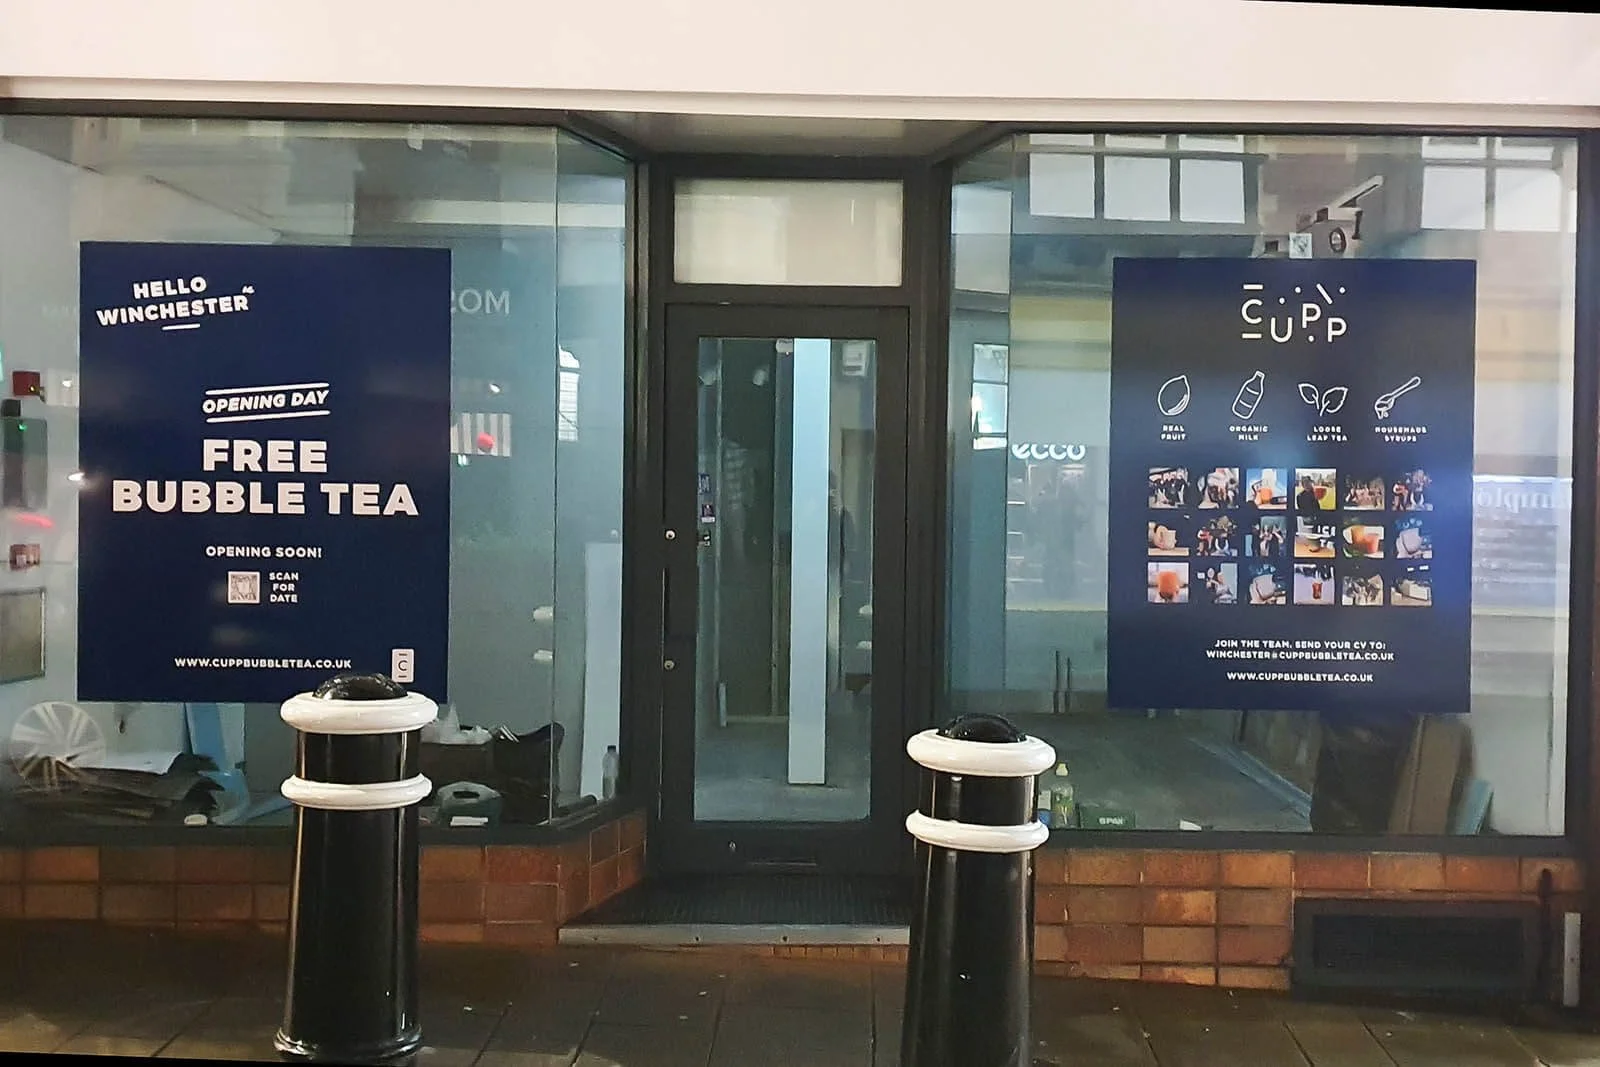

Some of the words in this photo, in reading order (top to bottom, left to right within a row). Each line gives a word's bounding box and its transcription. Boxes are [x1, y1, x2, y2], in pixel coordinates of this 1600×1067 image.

[132, 276, 207, 299] HELLO
[1241, 299, 1346, 342] CUPP
[203, 395, 286, 413] OPENING
[291, 389, 329, 406] DAY
[1229, 425, 1268, 433] ORGANIC
[204, 439, 327, 472] FREE
[113, 480, 305, 514] BUBBLE
[320, 483, 418, 515] TEA
[205, 545, 272, 558] OPENING
[275, 546, 322, 558] SOON!
[269, 572, 299, 581] SCAN
[272, 583, 295, 592] FOR
[269, 593, 298, 603] DATE
[1214, 639, 1238, 648] JOIN
[1240, 639, 1260, 648] THE
[1295, 640, 1322, 649] SEND
[1323, 640, 1351, 650] YOUR
[1353, 640, 1367, 650] CV
[174, 658, 352, 669] WWW.CUPPBUBBLETEA.CO.UK
[1226, 672, 1374, 682] WWW.CUPPBUBBLETEA.CO.UK
